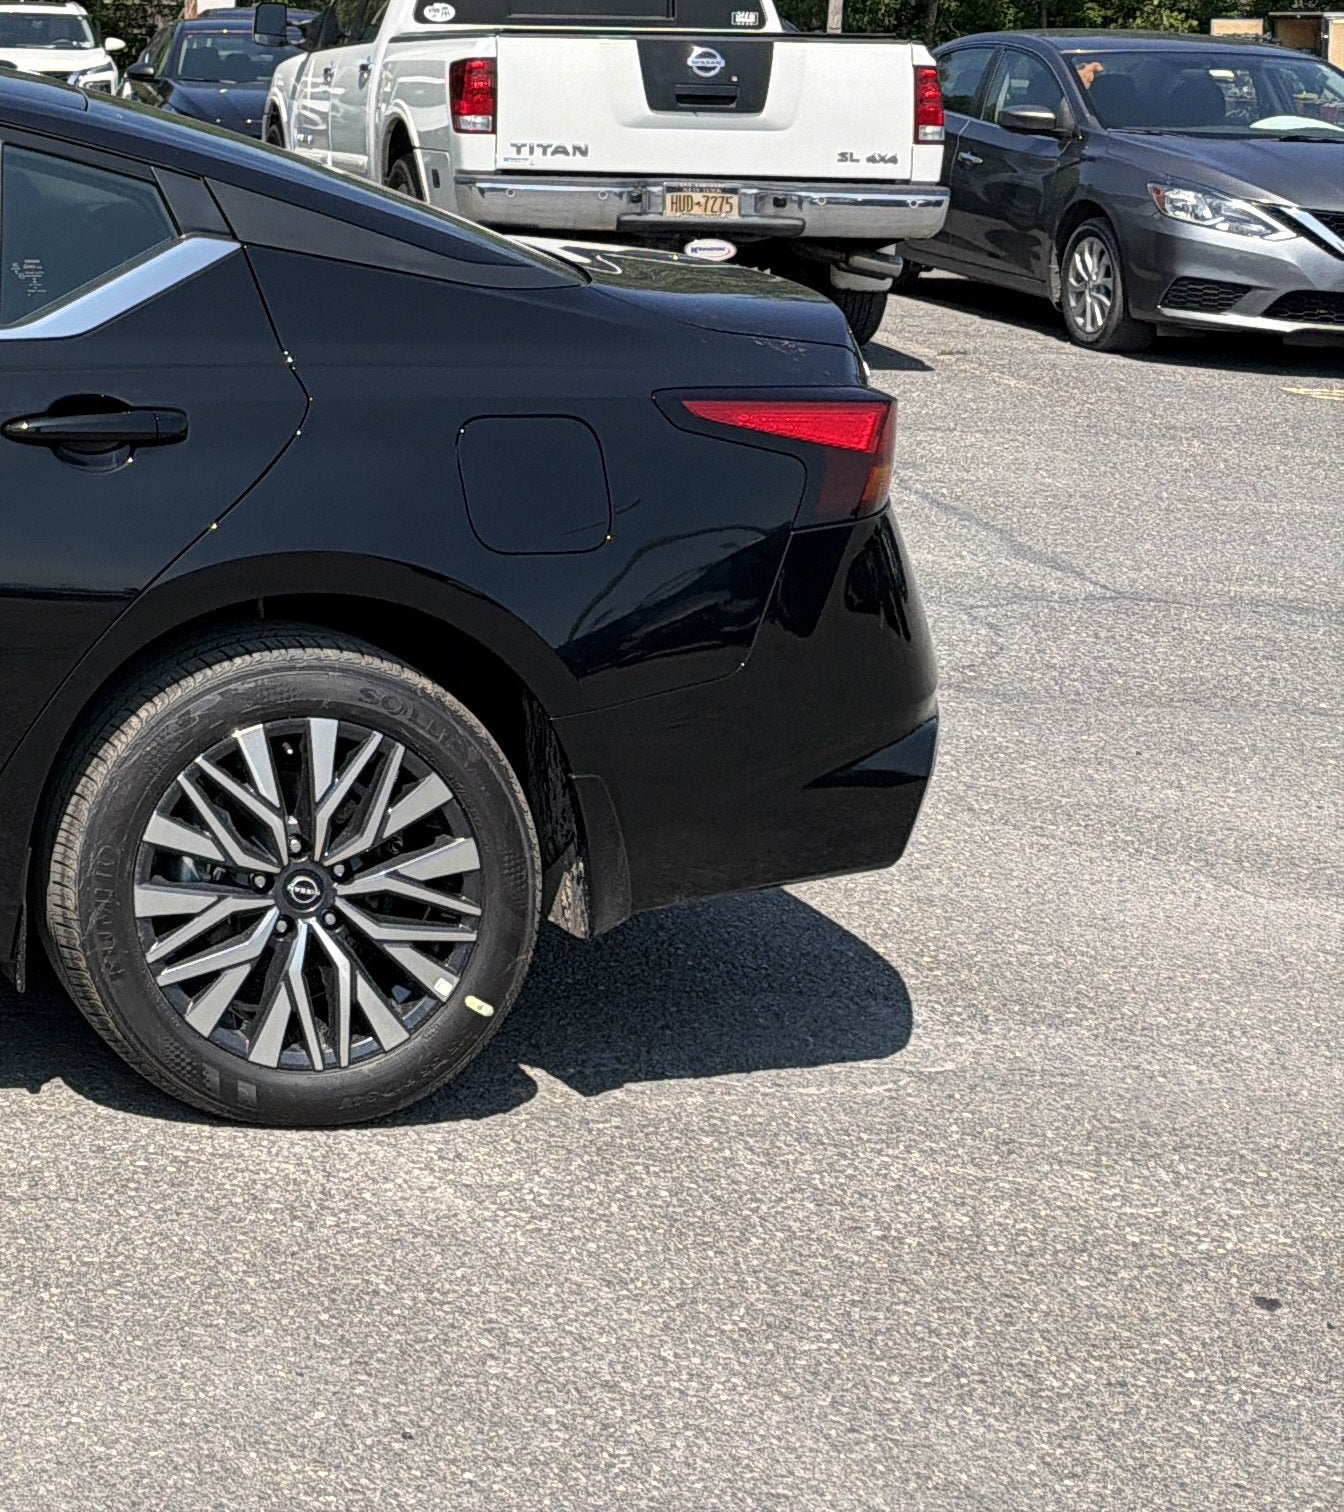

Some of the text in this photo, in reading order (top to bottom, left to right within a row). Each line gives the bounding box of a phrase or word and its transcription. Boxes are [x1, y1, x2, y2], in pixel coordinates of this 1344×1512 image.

[509, 142, 590, 158] TITAN
[836, 151, 861, 163] SL
[670, 194, 734, 214] HUD 7275
